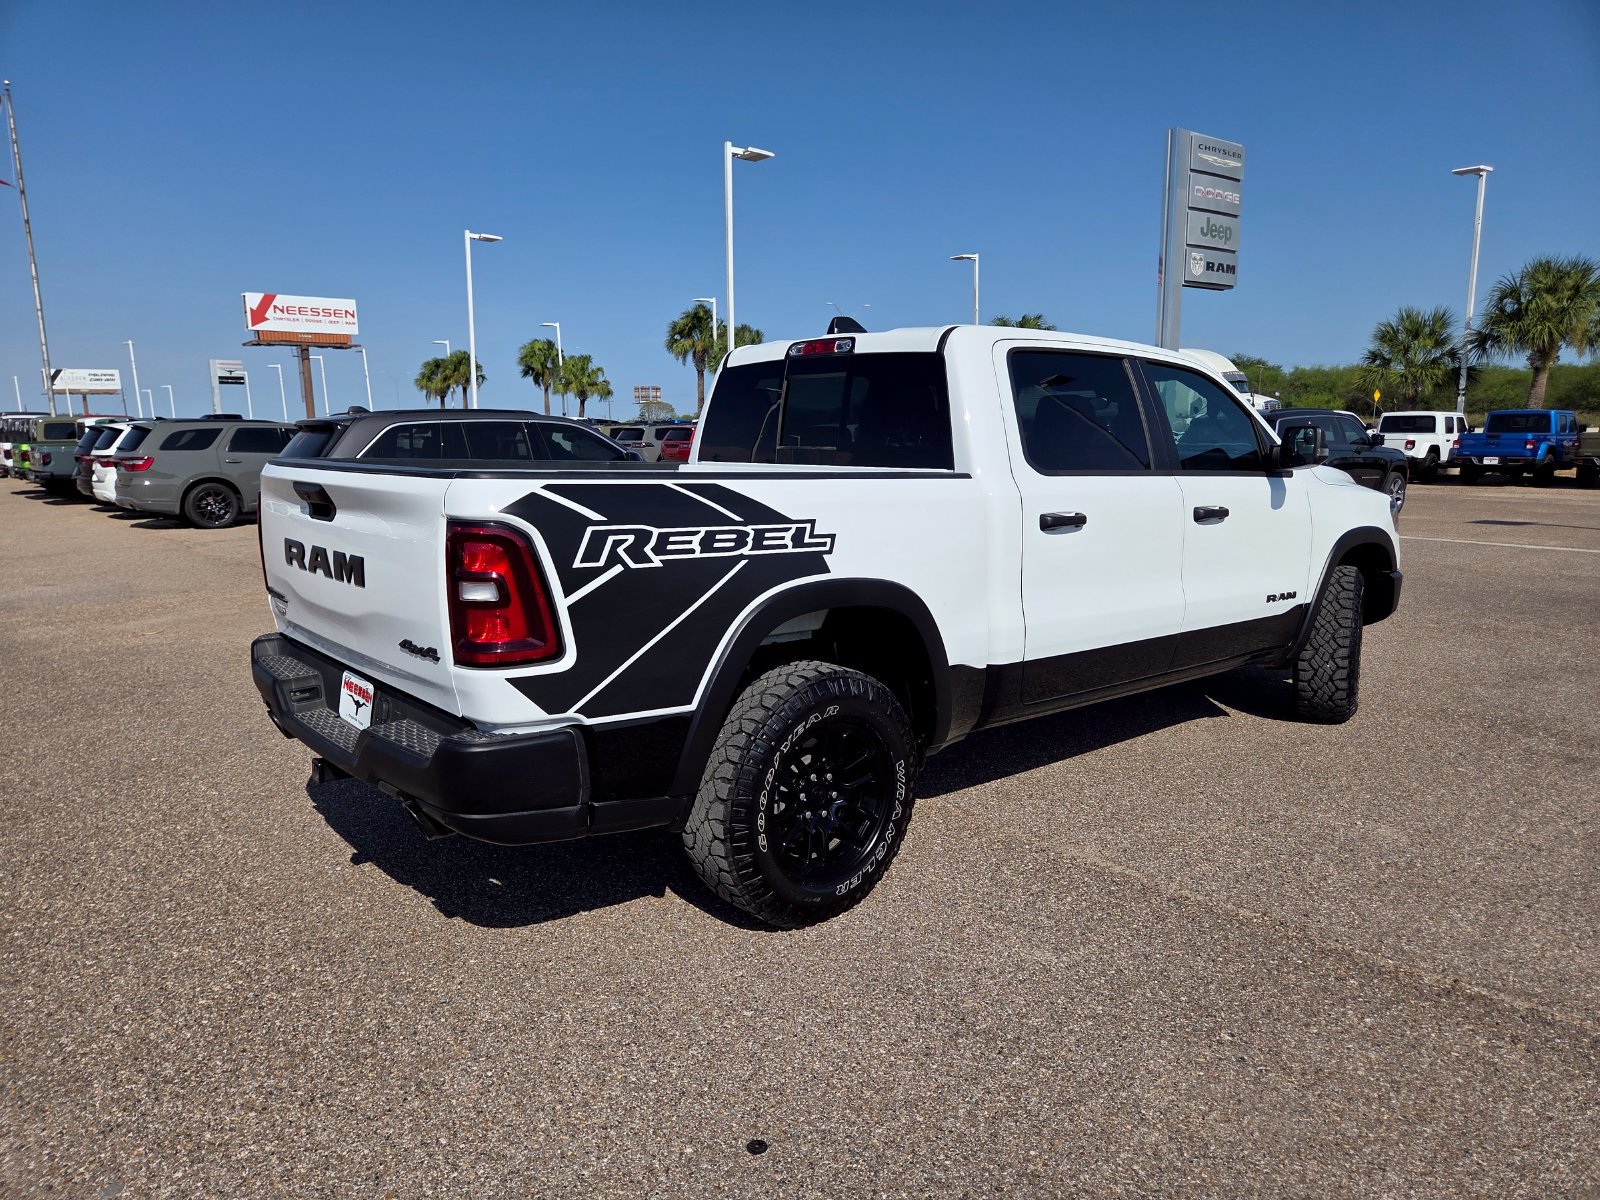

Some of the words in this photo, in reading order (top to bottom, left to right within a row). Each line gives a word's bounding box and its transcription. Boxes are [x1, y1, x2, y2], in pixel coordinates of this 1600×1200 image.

[1198, 143, 1242, 160] CHRYSLER
[1195, 186, 1240, 204] DODGE
[1200, 217, 1232, 245] Jeep
[1205, 261, 1236, 275] RAM
[272, 304, 355, 319] NEESSEN
[572, 519, 836, 569] REBEL
[284, 537, 366, 589] RAM
[1266, 591, 1297, 603] RAM
[757, 704, 840, 853] GOODYEAR
[835, 759, 906, 896] WRANGLER
